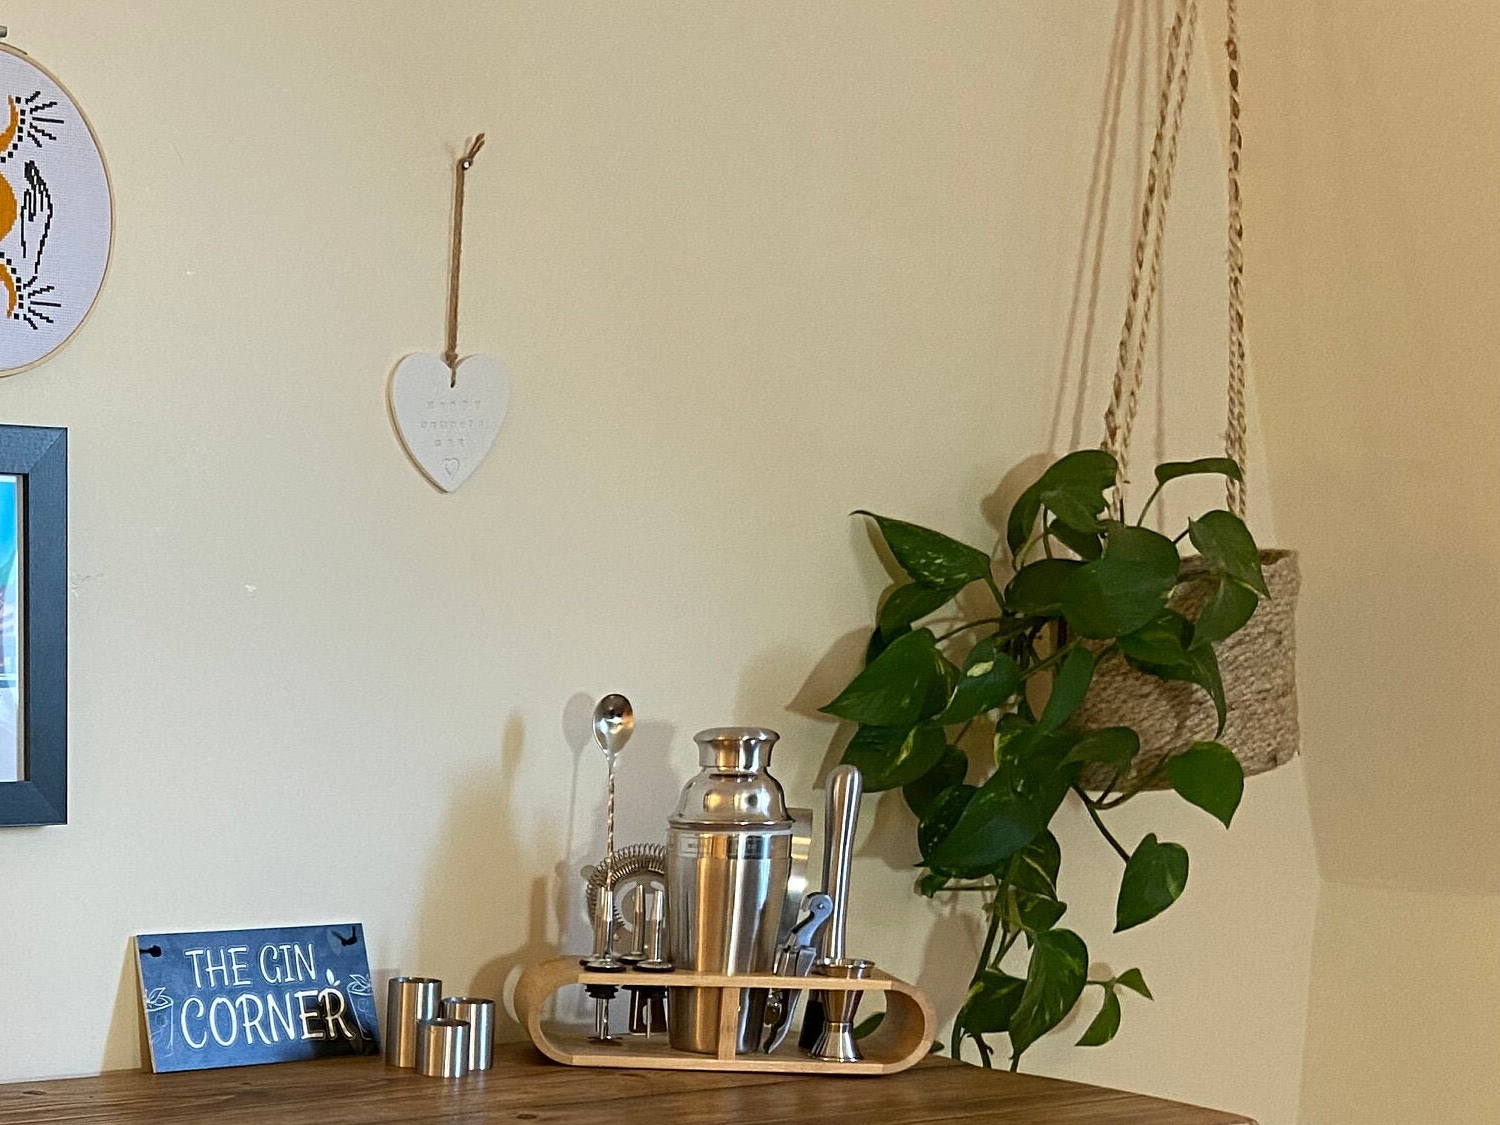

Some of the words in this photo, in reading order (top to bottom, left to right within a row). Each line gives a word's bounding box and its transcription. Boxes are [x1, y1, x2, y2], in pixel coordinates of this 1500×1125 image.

[185, 947, 251, 988] THE
[259, 943, 316, 984] GIN
[181, 988, 356, 1048] CORNER
